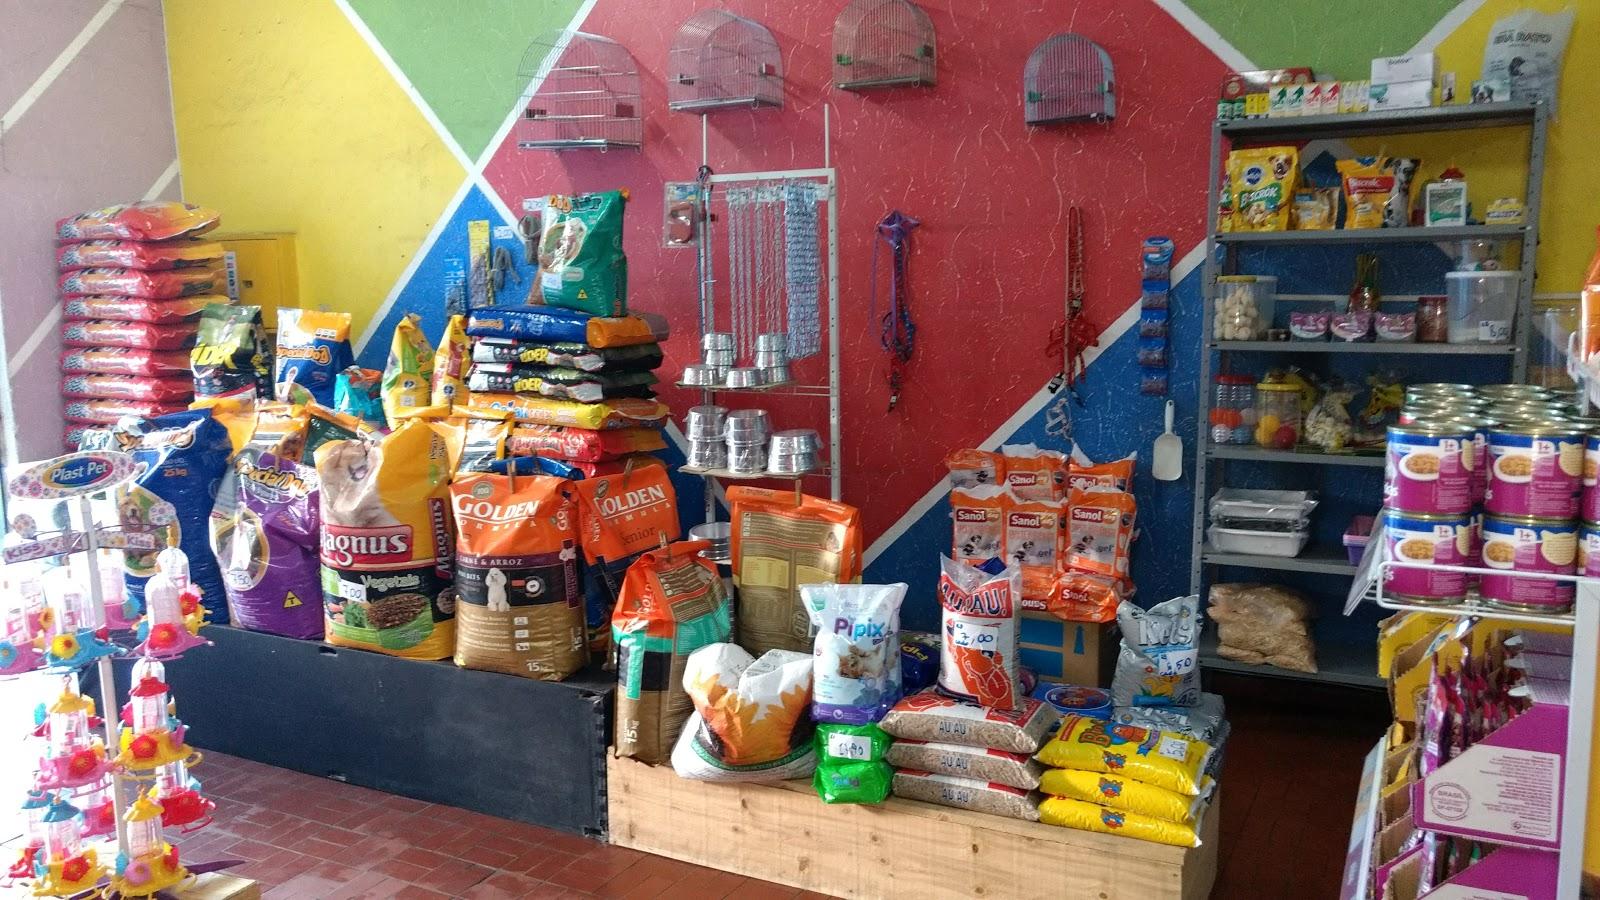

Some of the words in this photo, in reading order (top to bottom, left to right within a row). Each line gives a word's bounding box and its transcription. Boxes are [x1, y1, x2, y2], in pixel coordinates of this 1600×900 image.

[51, 467, 84, 482] Plast
[87, 461, 109, 476] Pet
[1010, 474, 1035, 485] Sanol
[453, 493, 541, 520] GOLDEN
[957, 510, 985, 521] Sanol
[1011, 514, 1040, 526] Sanol
[1073, 508, 1102, 521] Sanol
[834, 617, 886, 641] Pipix
[940, 721, 952, 733] AU
[954, 723, 967, 735] AU
